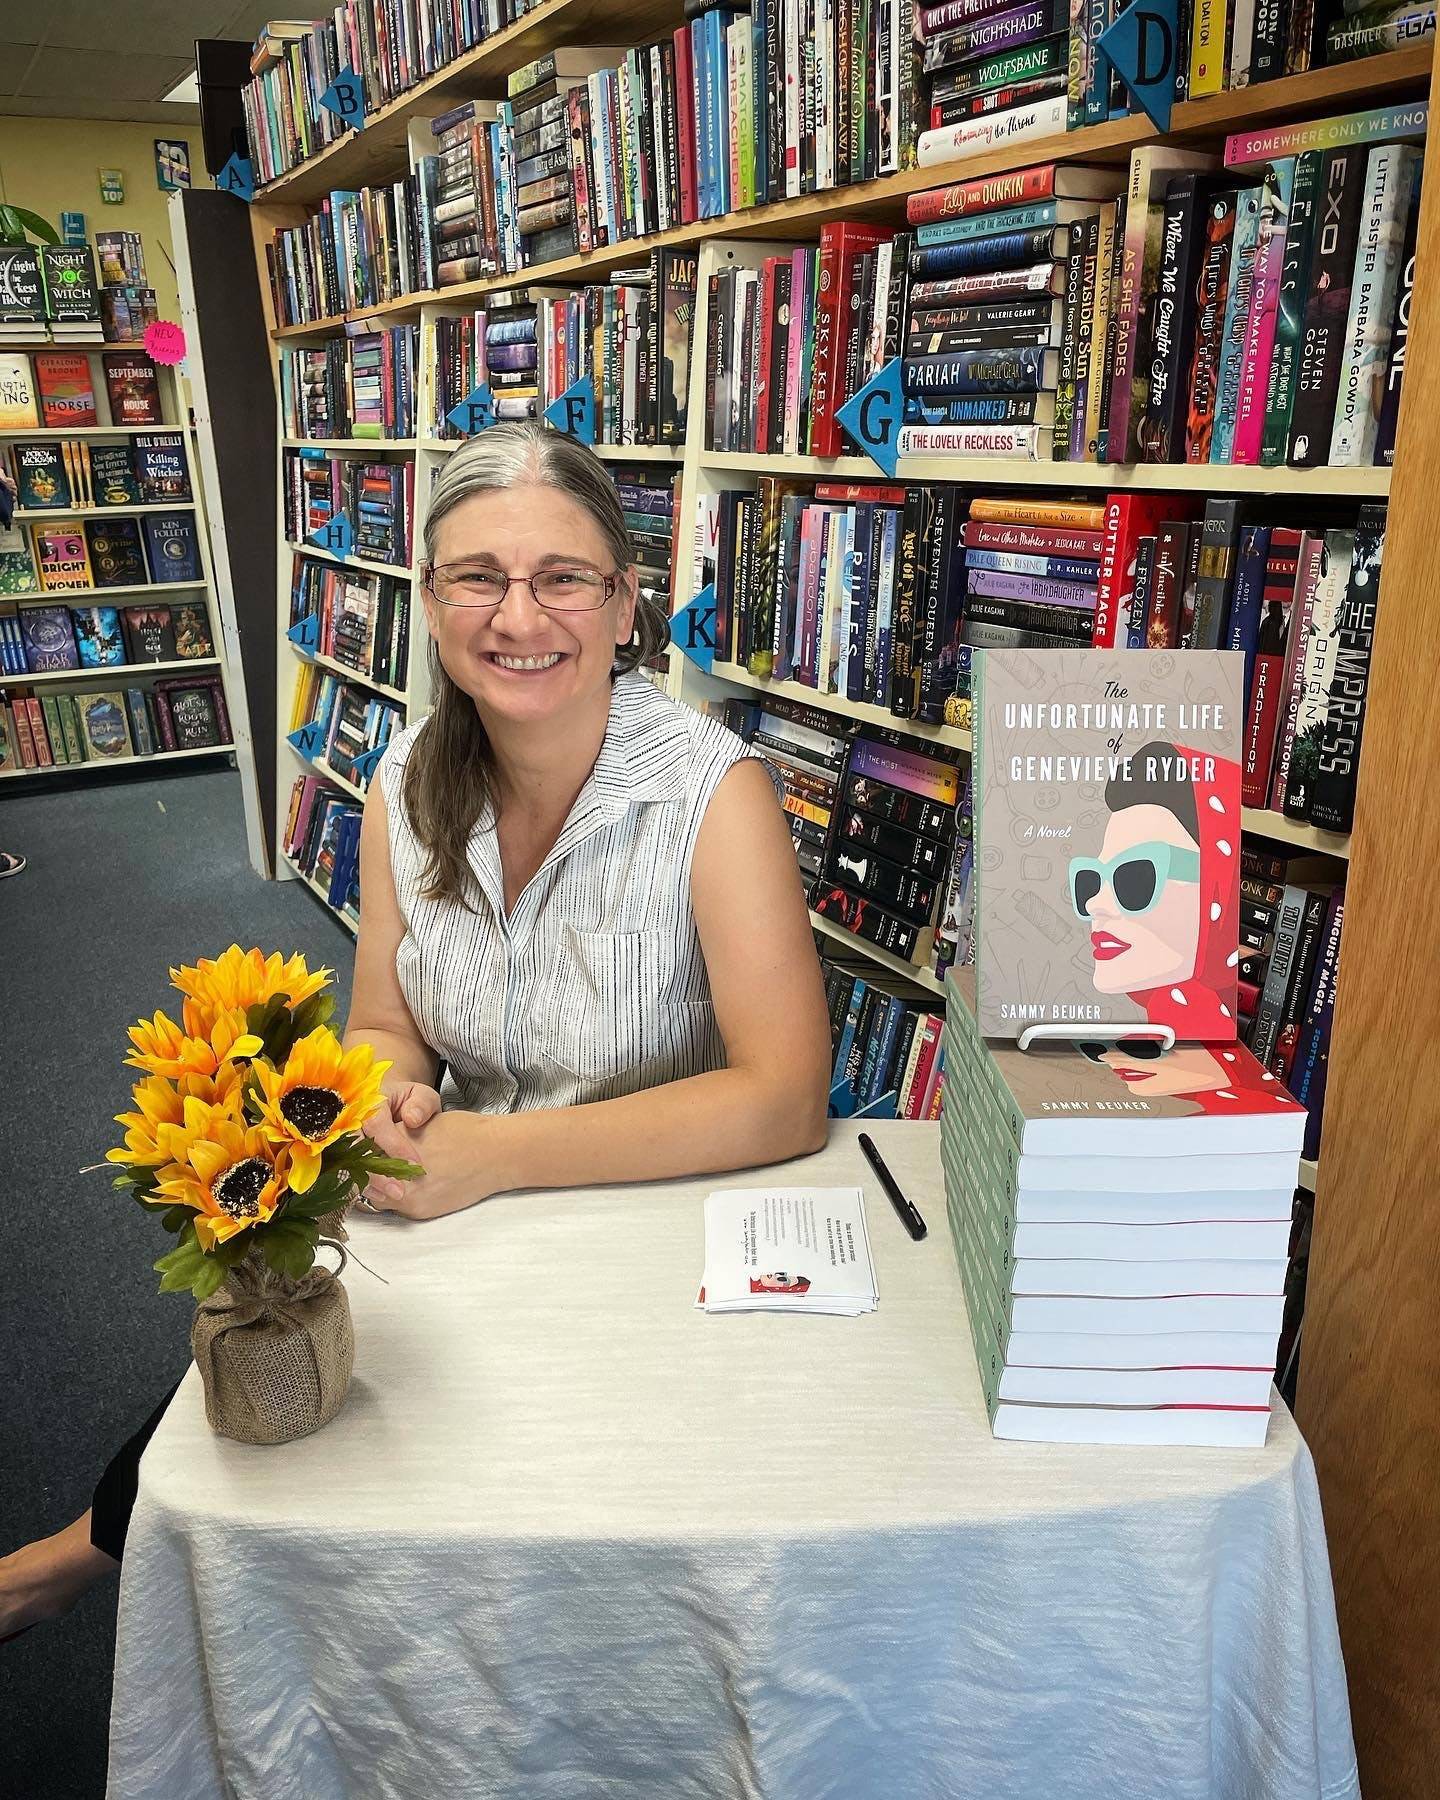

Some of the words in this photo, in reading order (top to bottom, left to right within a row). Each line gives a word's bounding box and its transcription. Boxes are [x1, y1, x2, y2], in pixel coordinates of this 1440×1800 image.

[927, 10, 945, 29] ONLY
[949, 3, 963, 20] THE
[970, 10, 1043, 48] NIGHTSHADE
[767, 2, 776, 85] CONRAD
[880, 30, 889, 47] TOP
[1134, 12, 1172, 86] D
[1334, 27, 1381, 50] DASHNER
[904, 34, 913, 90] BEFORE
[978, 49, 1049, 84] WOLFSBANE
[1068, 38, 1081, 102] NOW
[334, 85, 358, 115] B
[805, 90, 814, 136] MALICE
[942, 107, 966, 120] COUGHLIN
[983, 95, 998, 111] SHOT
[740, 72, 748, 176] MATCHED
[839, 101, 848, 165] HAWK
[851, 100, 864, 160] Queen
[953, 124, 993, 147] Romancing
[1007, 113, 1037, 136] Throne
[1246, 127, 1324, 154] SOMEWHERE
[1328, 121, 1364, 140] ONLY
[1368, 117, 1388, 132] WE
[1393, 111, 1428, 127] KNO
[228, 166, 246, 189] A
[967, 191, 981, 204] AND
[982, 176, 1025, 205] DUNKIN
[1132, 159, 1141, 199] GLINES
[1369, 158, 1388, 213] LITTLE
[1320, 158, 1347, 255] EXO
[1089, 224, 1098, 248] GILL
[1164, 211, 1183, 265] When
[1262, 208, 1274, 239] THE
[1103, 226, 1113, 260] INK
[1258, 243, 1270, 274] WAY
[1363, 218, 1380, 272] SISTER
[46, 254, 87, 266] NIGHT
[1124, 250, 1136, 272] AS
[50, 288, 91, 299] WITCH
[1067, 255, 1081, 303] blood
[1100, 267, 1112, 317] MAGE
[1162, 267, 1178, 293] We
[1254, 279, 1266, 310] YOU
[1079, 255, 1097, 337] Invisible
[1120, 278, 1134, 313] SHE
[987, 310, 1013, 320] VALERIE
[1014, 308, 1036, 317] GEARY
[1067, 307, 1076, 332] from
[1155, 298, 1174, 358] Caught
[1351, 283, 1372, 360] BARBARA
[819, 314, 830, 359] SKY
[850, 328, 859, 367] RULES
[1115, 320, 1130, 377] FADES
[1249, 316, 1261, 356] MAKE
[1062, 334, 1075, 379] stone
[1077, 342, 1092, 380] Sun
[1245, 362, 1255, 382] ME
[1300, 329, 1315, 391] GOULD
[1312, 328, 1328, 391] STEVEN
[108, 368, 154, 379] SEPTEMBER
[908, 362, 960, 387] PARIAH
[1151, 358, 1169, 406] Fire
[48, 400, 91, 412] HORSE
[123, 400, 150, 410] HOUSE
[816, 371, 827, 417] KEY
[1241, 388, 1253, 420] FEEL
[1277, 393, 1288, 411] NEXT
[1343, 364, 1360, 424] GOWDY
[564, 397, 587, 435] F
[859, 390, 892, 445] G
[950, 400, 1007, 420] UNMARKED
[136, 437, 152, 447] BILL
[153, 436, 182, 447] O'REILLY
[912, 434, 929, 449] THE
[930, 434, 963, 449] LOVELY
[964, 434, 1013, 450] RECKLESS
[146, 467, 183, 478] Witches
[147, 454, 179, 466] Killing
[162, 521, 180, 529] KEN
[1013, 507, 1037, 520] Heart
[1059, 510, 1076, 522] Size
[1203, 519, 1226, 533] KERR
[154, 528, 190, 539] FOLLETT
[325, 525, 344, 549] H
[978, 528, 991, 543] Love
[1000, 530, 1018, 545] Other
[1055, 538, 1073, 550] JESSICA
[1073, 540, 1086, 550] KATE
[1102, 504, 1120, 578] GUTTER
[42, 562, 86, 574] BRIGHT
[777, 540, 786, 566] THIS
[931, 517, 944, 590] SEVENTH
[969, 553, 985, 565] PALE
[986, 554, 1012, 568] QUEEN
[1014, 558, 1042, 571] RISING
[1066, 566, 1093, 576] KAHLER
[1309, 552, 1321, 579] KIELY
[46, 580, 90, 591] WOMEN
[777, 568, 785, 581] IS
[806, 540, 818, 622] abandon
[740, 571, 748, 613] HEADLINES
[776, 583, 784, 601] MY
[1049, 581, 1085, 602] DAUGHTER
[1131, 567, 1148, 631] FROZEN
[1234, 572, 1244, 613] KHORANA
[1242, 582, 1251, 605] ADITI
[1302, 583, 1315, 612] THE
[1321, 567, 1337, 631] KHOURY
[925, 597, 938, 651] QUEEN
[970, 604, 983, 614] JULIE
[984, 605, 1006, 617] KAGAWA
[1096, 584, 1111, 637] MAGE
[1341, 601, 1376, 630] THE
[300, 624, 314, 646] L
[686, 608, 716, 649] K
[773, 602, 783, 656] AMERICA
[1298, 616, 1311, 653] LAST
[1293, 654, 1306, 691] TRUE
[1306, 639, 1329, 720] ORIGIN
[1104, 681, 1129, 699] The
[1319, 628, 1374, 776] EMPRESS
[802, 717, 830, 731] ACADEMY
[806, 710, 829, 723] VAMPIRE
[1004, 703, 1166, 729] UNFORTUNATE
[1179, 704, 1224, 730] LIFE
[1246, 662, 1269, 774] TRADITION
[1286, 696, 1298, 731] LOVE
[298, 730, 317, 751] N
[1107, 733, 1124, 755] of
[869, 755, 881, 765] THE
[880, 758, 899, 771] HOST
[1010, 756, 1133, 782] GENEVIEVE
[1146, 757, 1216, 783] RYDER
[1280, 735, 1293, 780] STORY
[1024, 825, 1033, 838] A
[1037, 825, 1071, 838] Novel
[1281, 905, 1300, 930] TIN
[1323, 904, 1345, 967] LINGUIST
[1272, 933, 1294, 978] SWIFT
[1313, 969, 1329, 1014] MAGES
[1001, 1004, 1046, 1019] SAMMY
[1052, 1005, 1101, 1020] BEUKER
[868, 1037, 880, 1058] Not
[1307, 1028, 1322, 1068] SCOTTO
[1041, 1101, 1090, 1111] SAMMY
[1095, 1101, 1151, 1111] BEUKER
